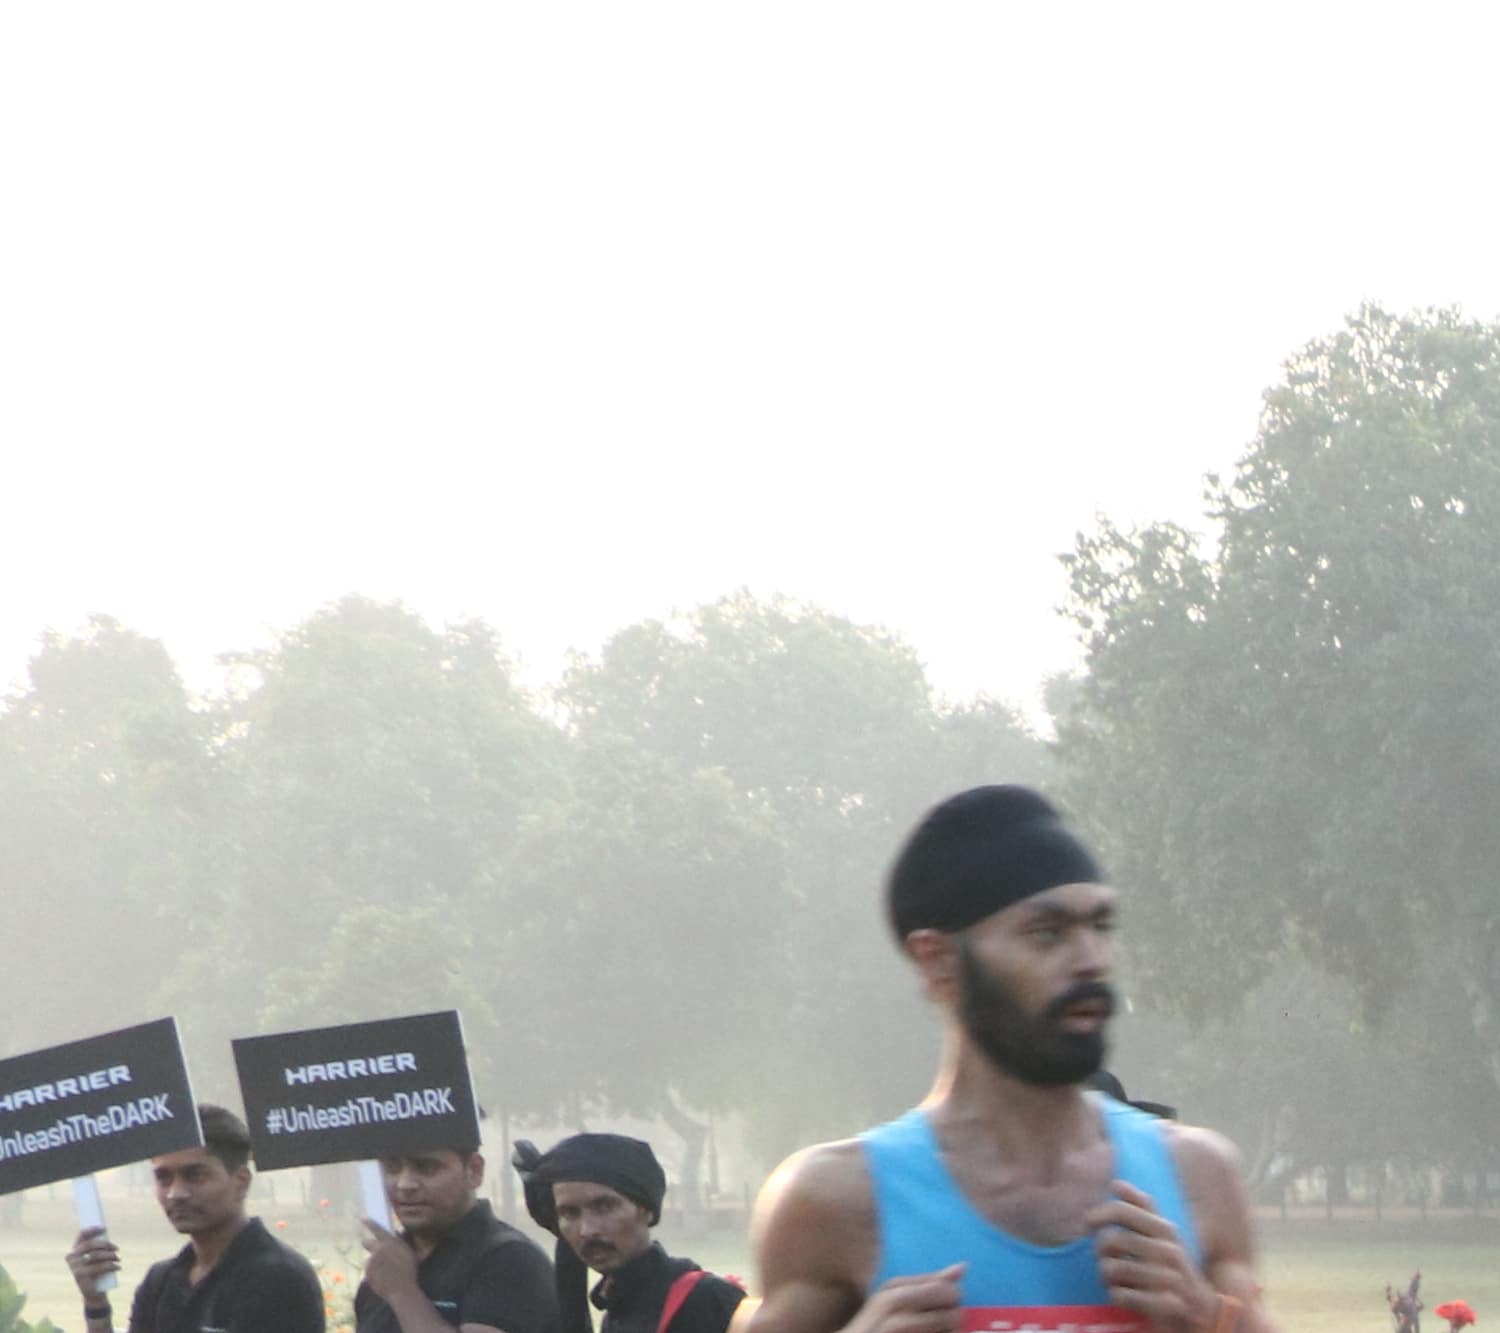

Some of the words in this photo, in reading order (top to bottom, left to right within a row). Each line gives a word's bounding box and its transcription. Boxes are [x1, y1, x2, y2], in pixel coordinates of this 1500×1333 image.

[284, 1052, 417, 1086] HARRIER
[0, 1093, 174, 1160] nleashTheDARK
[266, 1087, 455, 1135] #UnleashTheDARK
